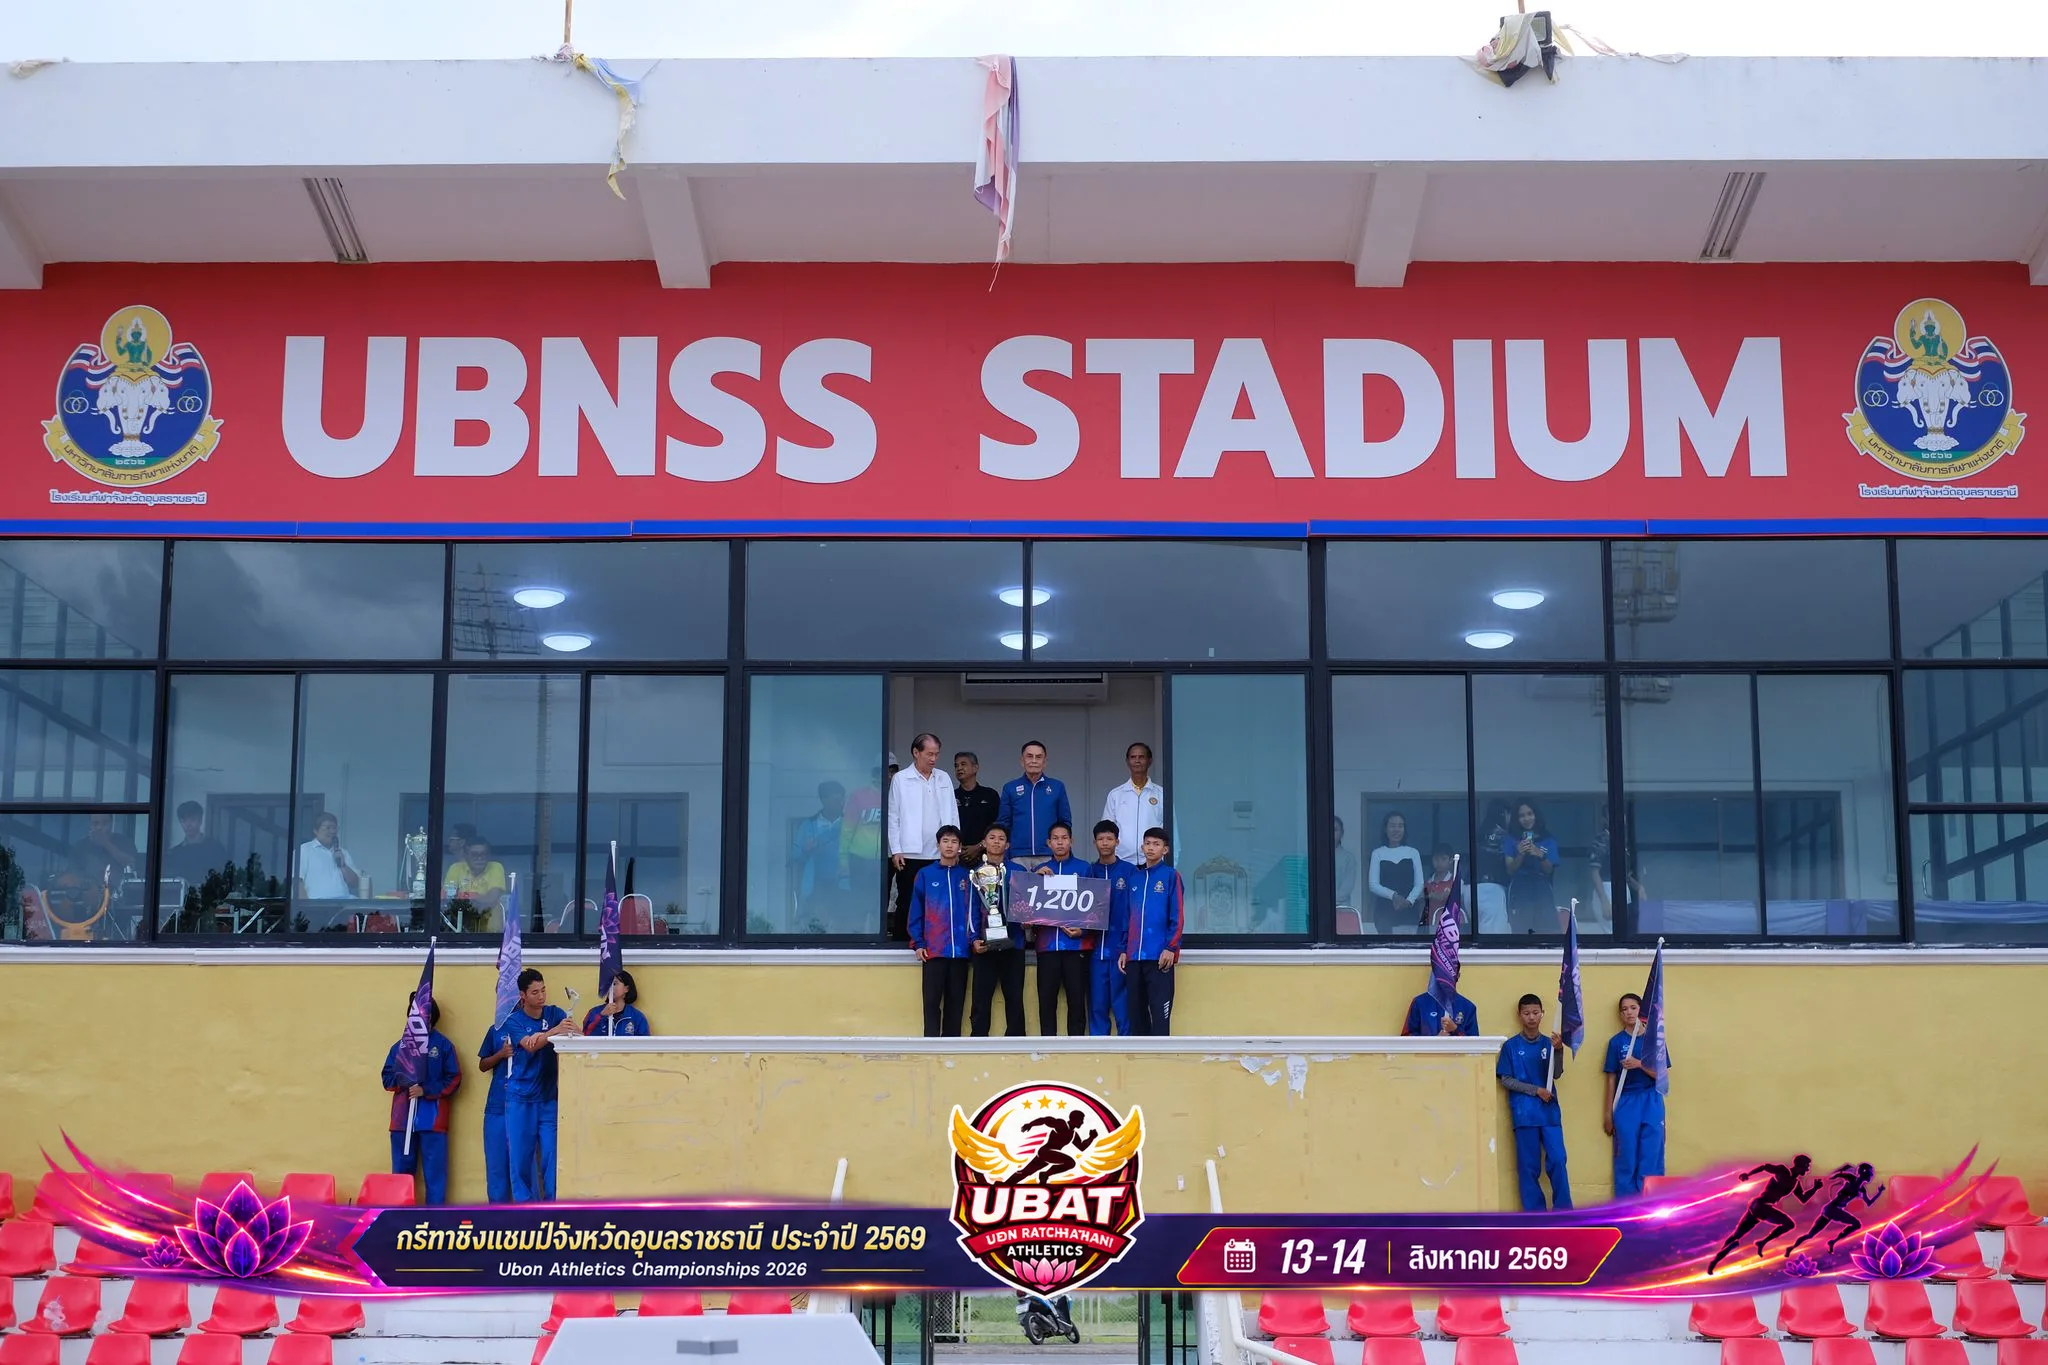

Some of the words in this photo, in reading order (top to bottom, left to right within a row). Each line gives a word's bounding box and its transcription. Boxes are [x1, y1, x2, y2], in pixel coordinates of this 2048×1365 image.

[282, 335, 878, 484] UBNSS
[978, 335, 1788, 482] STADIUM
[1027, 885, 1094, 912] 1,200
